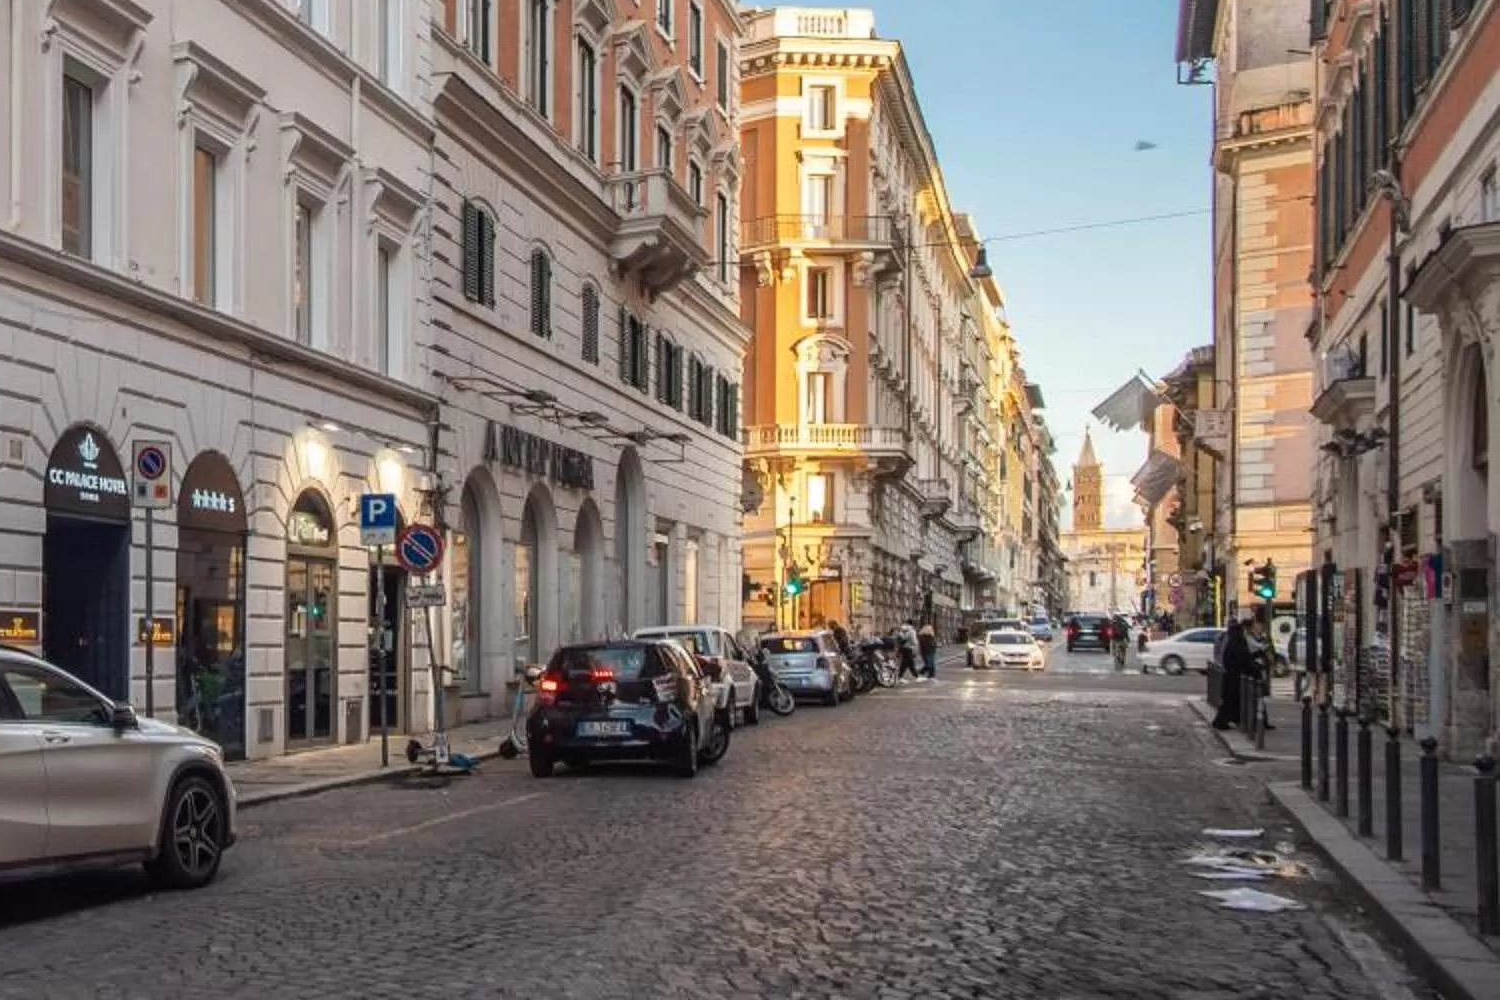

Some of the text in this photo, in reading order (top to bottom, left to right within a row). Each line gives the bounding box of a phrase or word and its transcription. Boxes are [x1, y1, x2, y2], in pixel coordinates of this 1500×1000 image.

[49, 468, 127, 495] CC PALACE HOTEL
[369, 500, 387, 523] P
